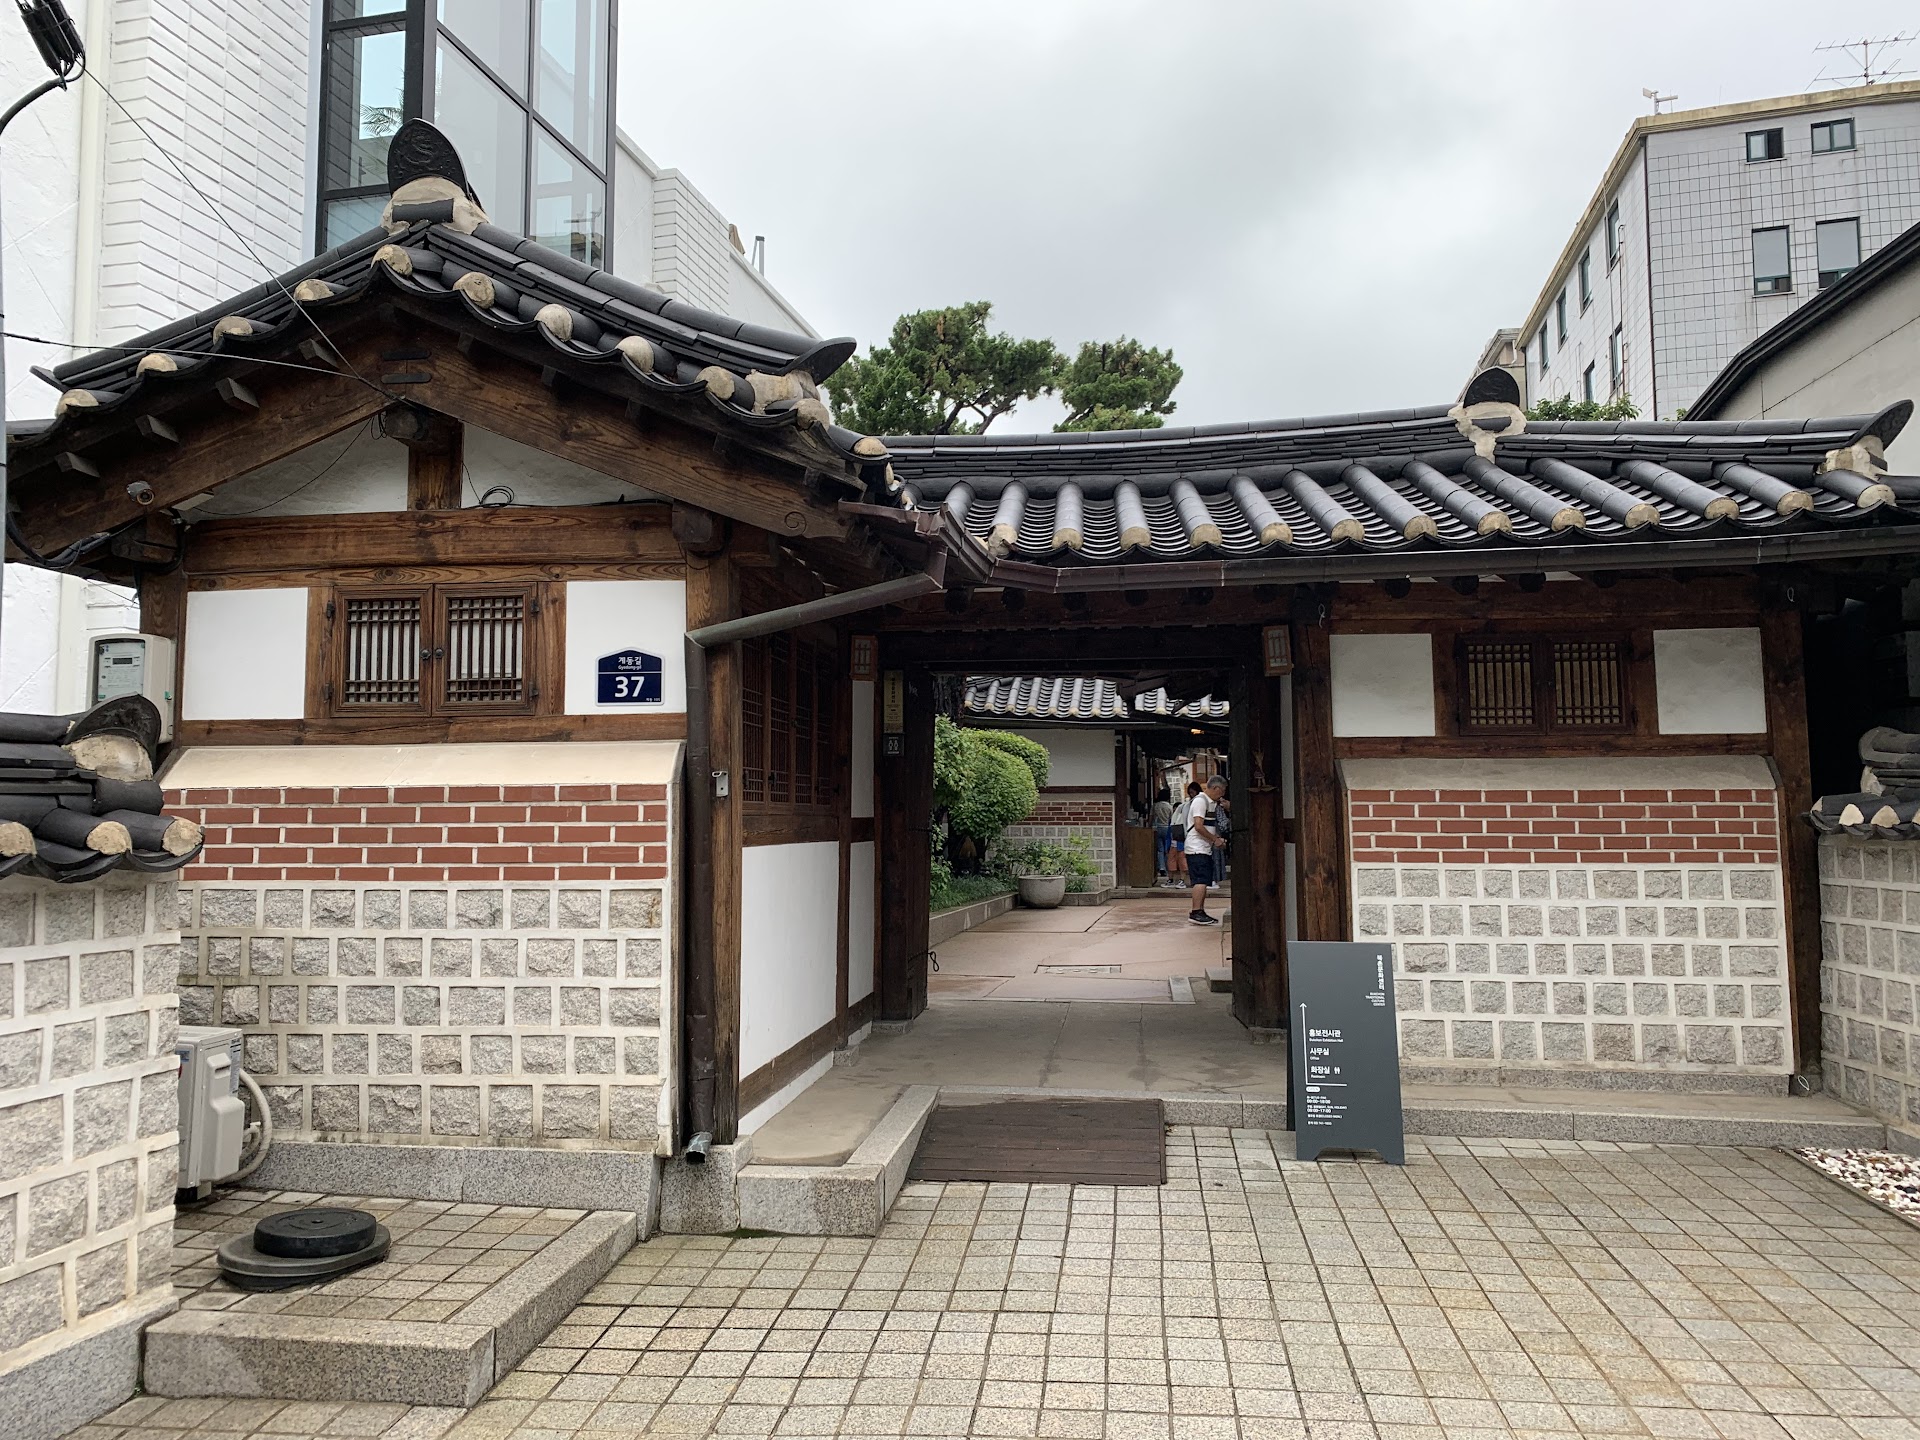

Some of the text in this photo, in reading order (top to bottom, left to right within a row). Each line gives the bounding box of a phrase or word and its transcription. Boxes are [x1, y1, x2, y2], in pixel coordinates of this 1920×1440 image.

[618, 656, 642, 666] 계동길
[614, 675, 645, 698] 37
[1308, 1028, 1341, 1038] 홍보전시관
[1309, 1047, 1330, 1056] 사무실
[1310, 1065, 1330, 1075] 화장실
